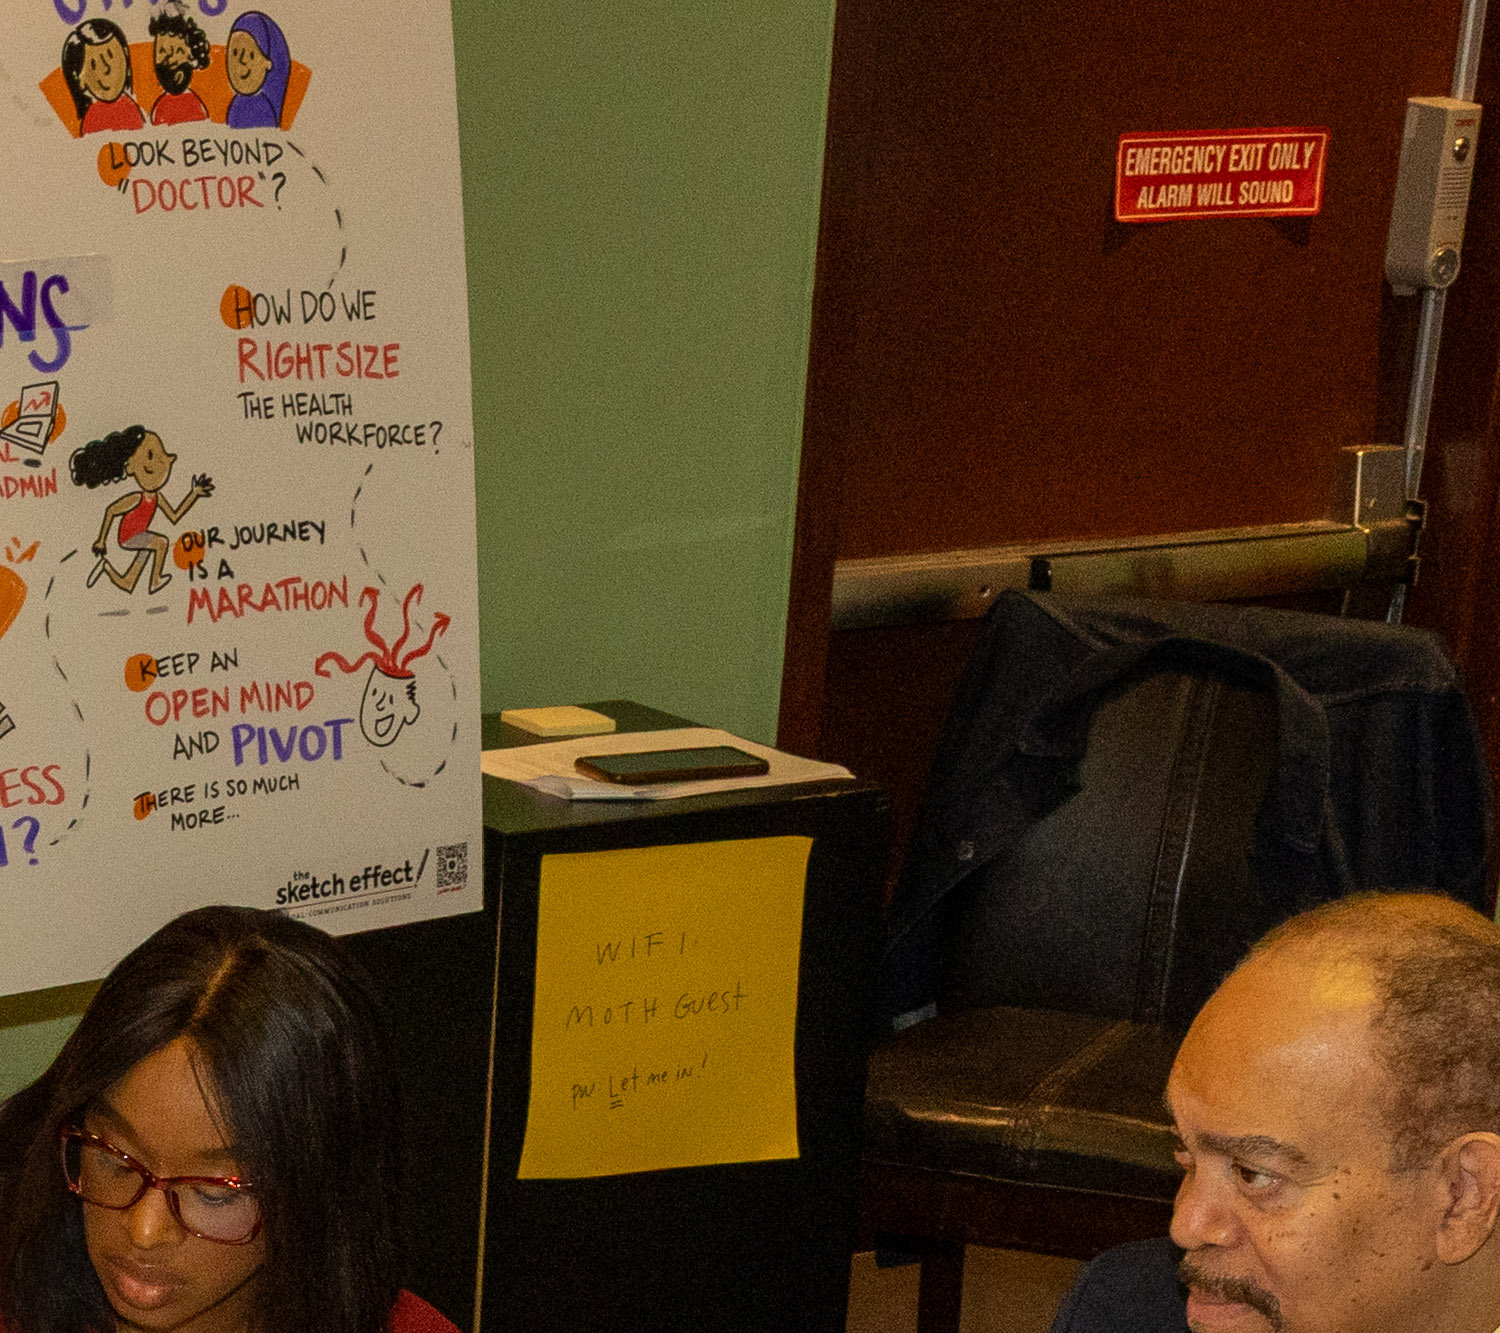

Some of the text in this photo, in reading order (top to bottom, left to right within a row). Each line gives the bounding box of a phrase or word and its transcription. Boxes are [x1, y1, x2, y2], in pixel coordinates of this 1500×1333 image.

[109, 137, 283, 169] LOOK BEYOND
[1125, 141, 1316, 176] EMERGENCY EXIT ONLY
[1137, 180, 1294, 209] ALARM WILL SOUND
[233, 288, 377, 326] HOW DO WE
[238, 392, 353, 419] THE HEALTH
[296, 420, 442, 453] WORKFORCE?
[181, 519, 325, 552] OUR JOURNEY
[188, 557, 234, 580] IS A
[186, 576, 350, 623] MARATHON
[139, 648, 239, 682] KEEP AN
[145, 680, 315, 726] OPEN MIND
[172, 718, 355, 766] AND PIVOT
[134, 773, 300, 813] THERE IS SO MUCH
[276, 874, 345, 905] sketch
[293, 870, 310, 882] the
